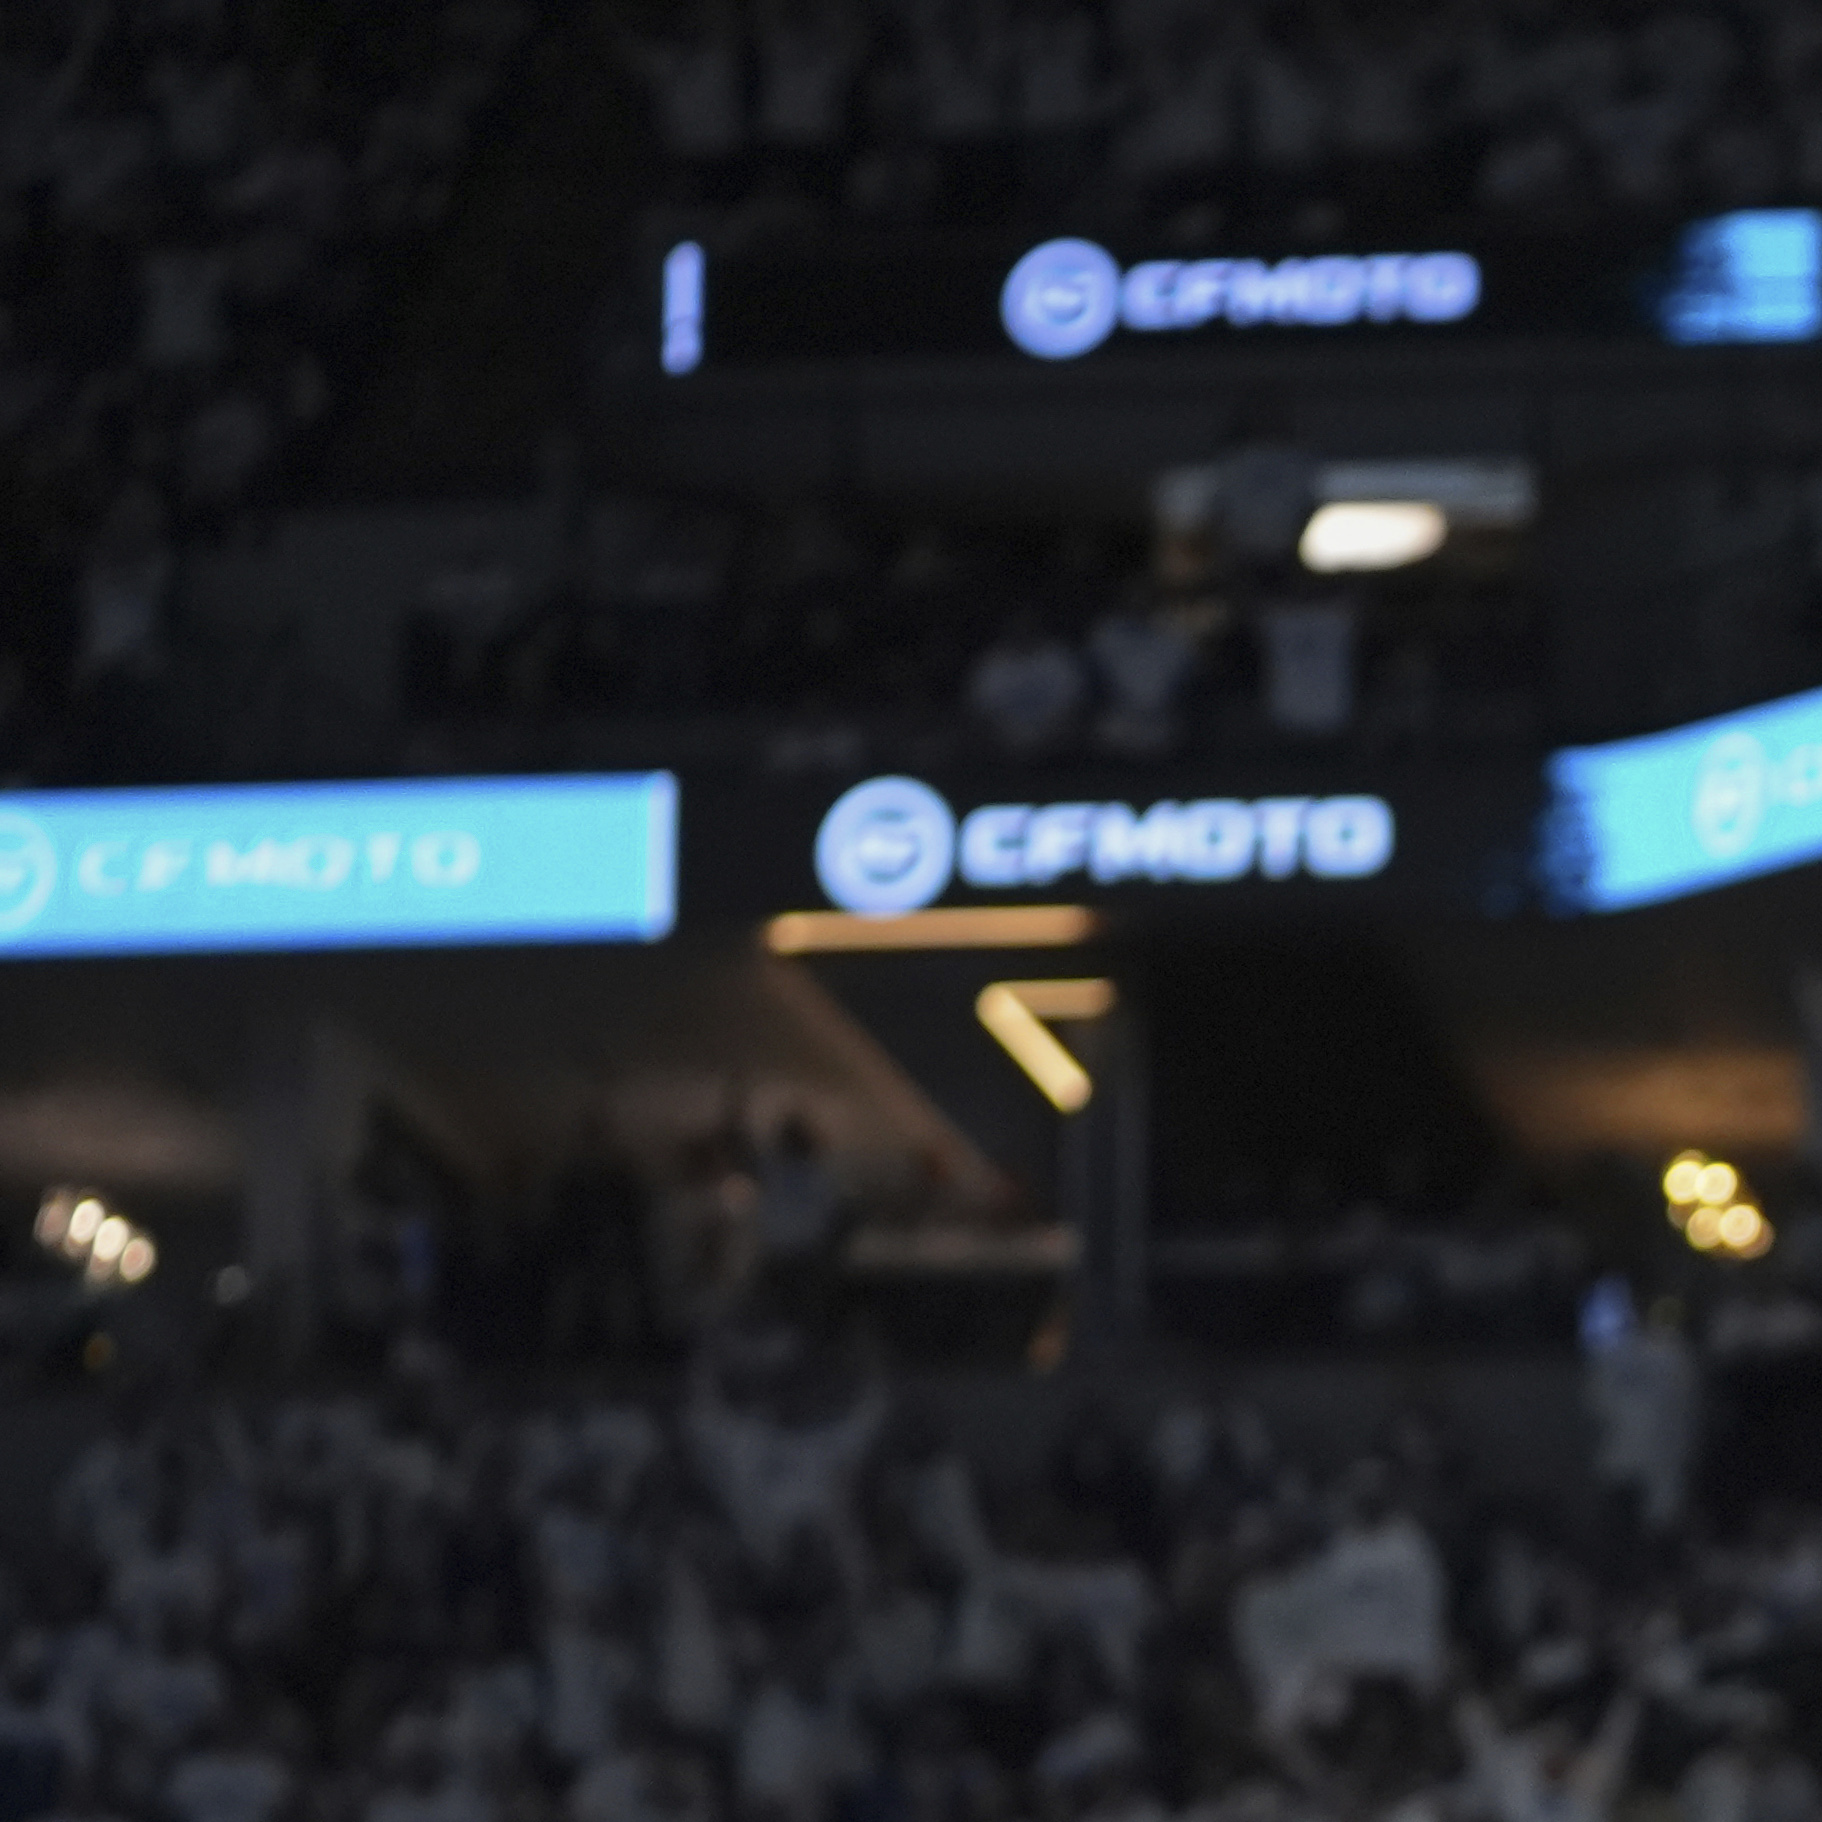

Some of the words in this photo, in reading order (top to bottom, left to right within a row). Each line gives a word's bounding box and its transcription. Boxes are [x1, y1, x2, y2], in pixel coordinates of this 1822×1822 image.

[1122, 251, 1483, 333] CFMOTO
[79, 830, 481, 898] CFMOTO
[960, 794, 1395, 888] CFMOTO
